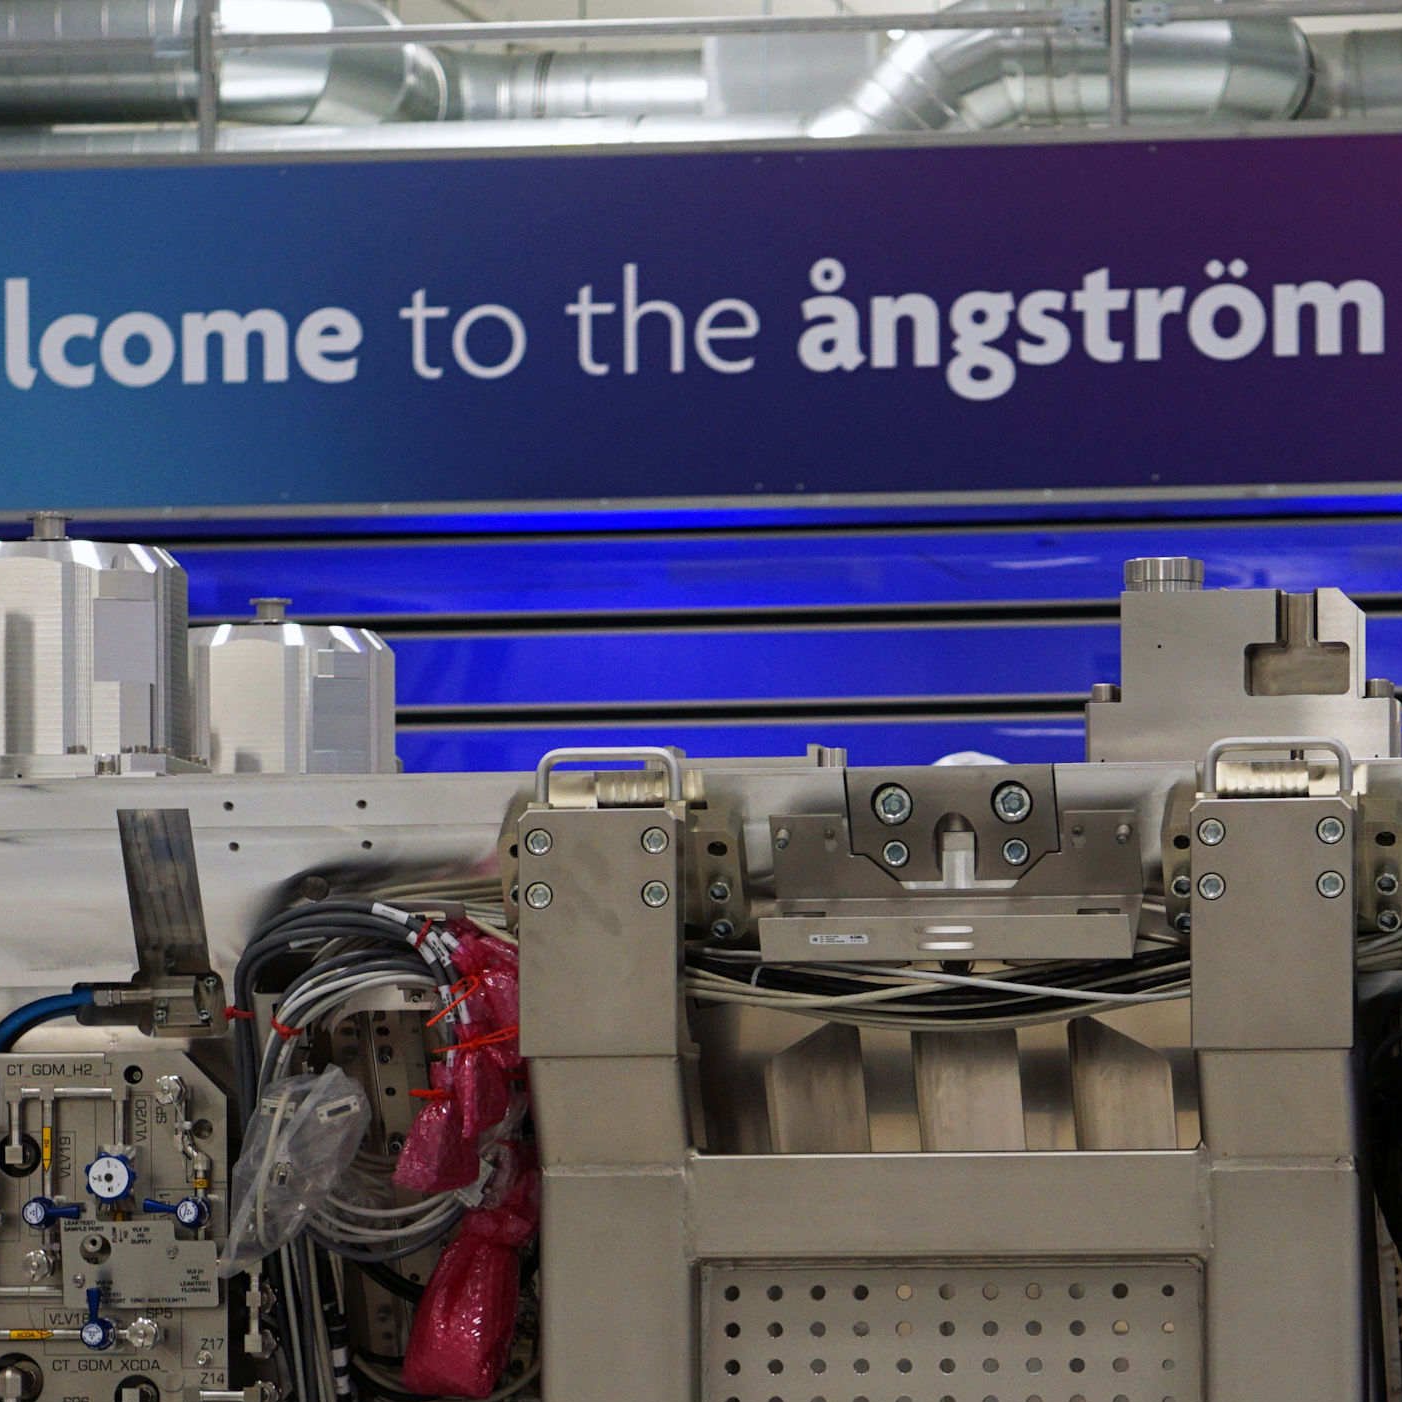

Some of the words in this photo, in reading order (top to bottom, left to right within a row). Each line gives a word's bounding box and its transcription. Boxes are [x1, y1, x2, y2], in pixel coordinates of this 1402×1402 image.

[400, 290, 525, 378] to
[566, 264, 758, 374] the
[799, 259, 1383, 399] ångström
[135, 1100, 147, 1142] VLV20
[155, 1100, 167, 1124] SP
[44, 1138, 50, 1148] H2
[60, 1137, 71, 1179] VLV19
[146, 1309, 173, 1319] SP5
[201, 1338, 224, 1349] Z17
[200, 1373, 224, 1385] Z14
